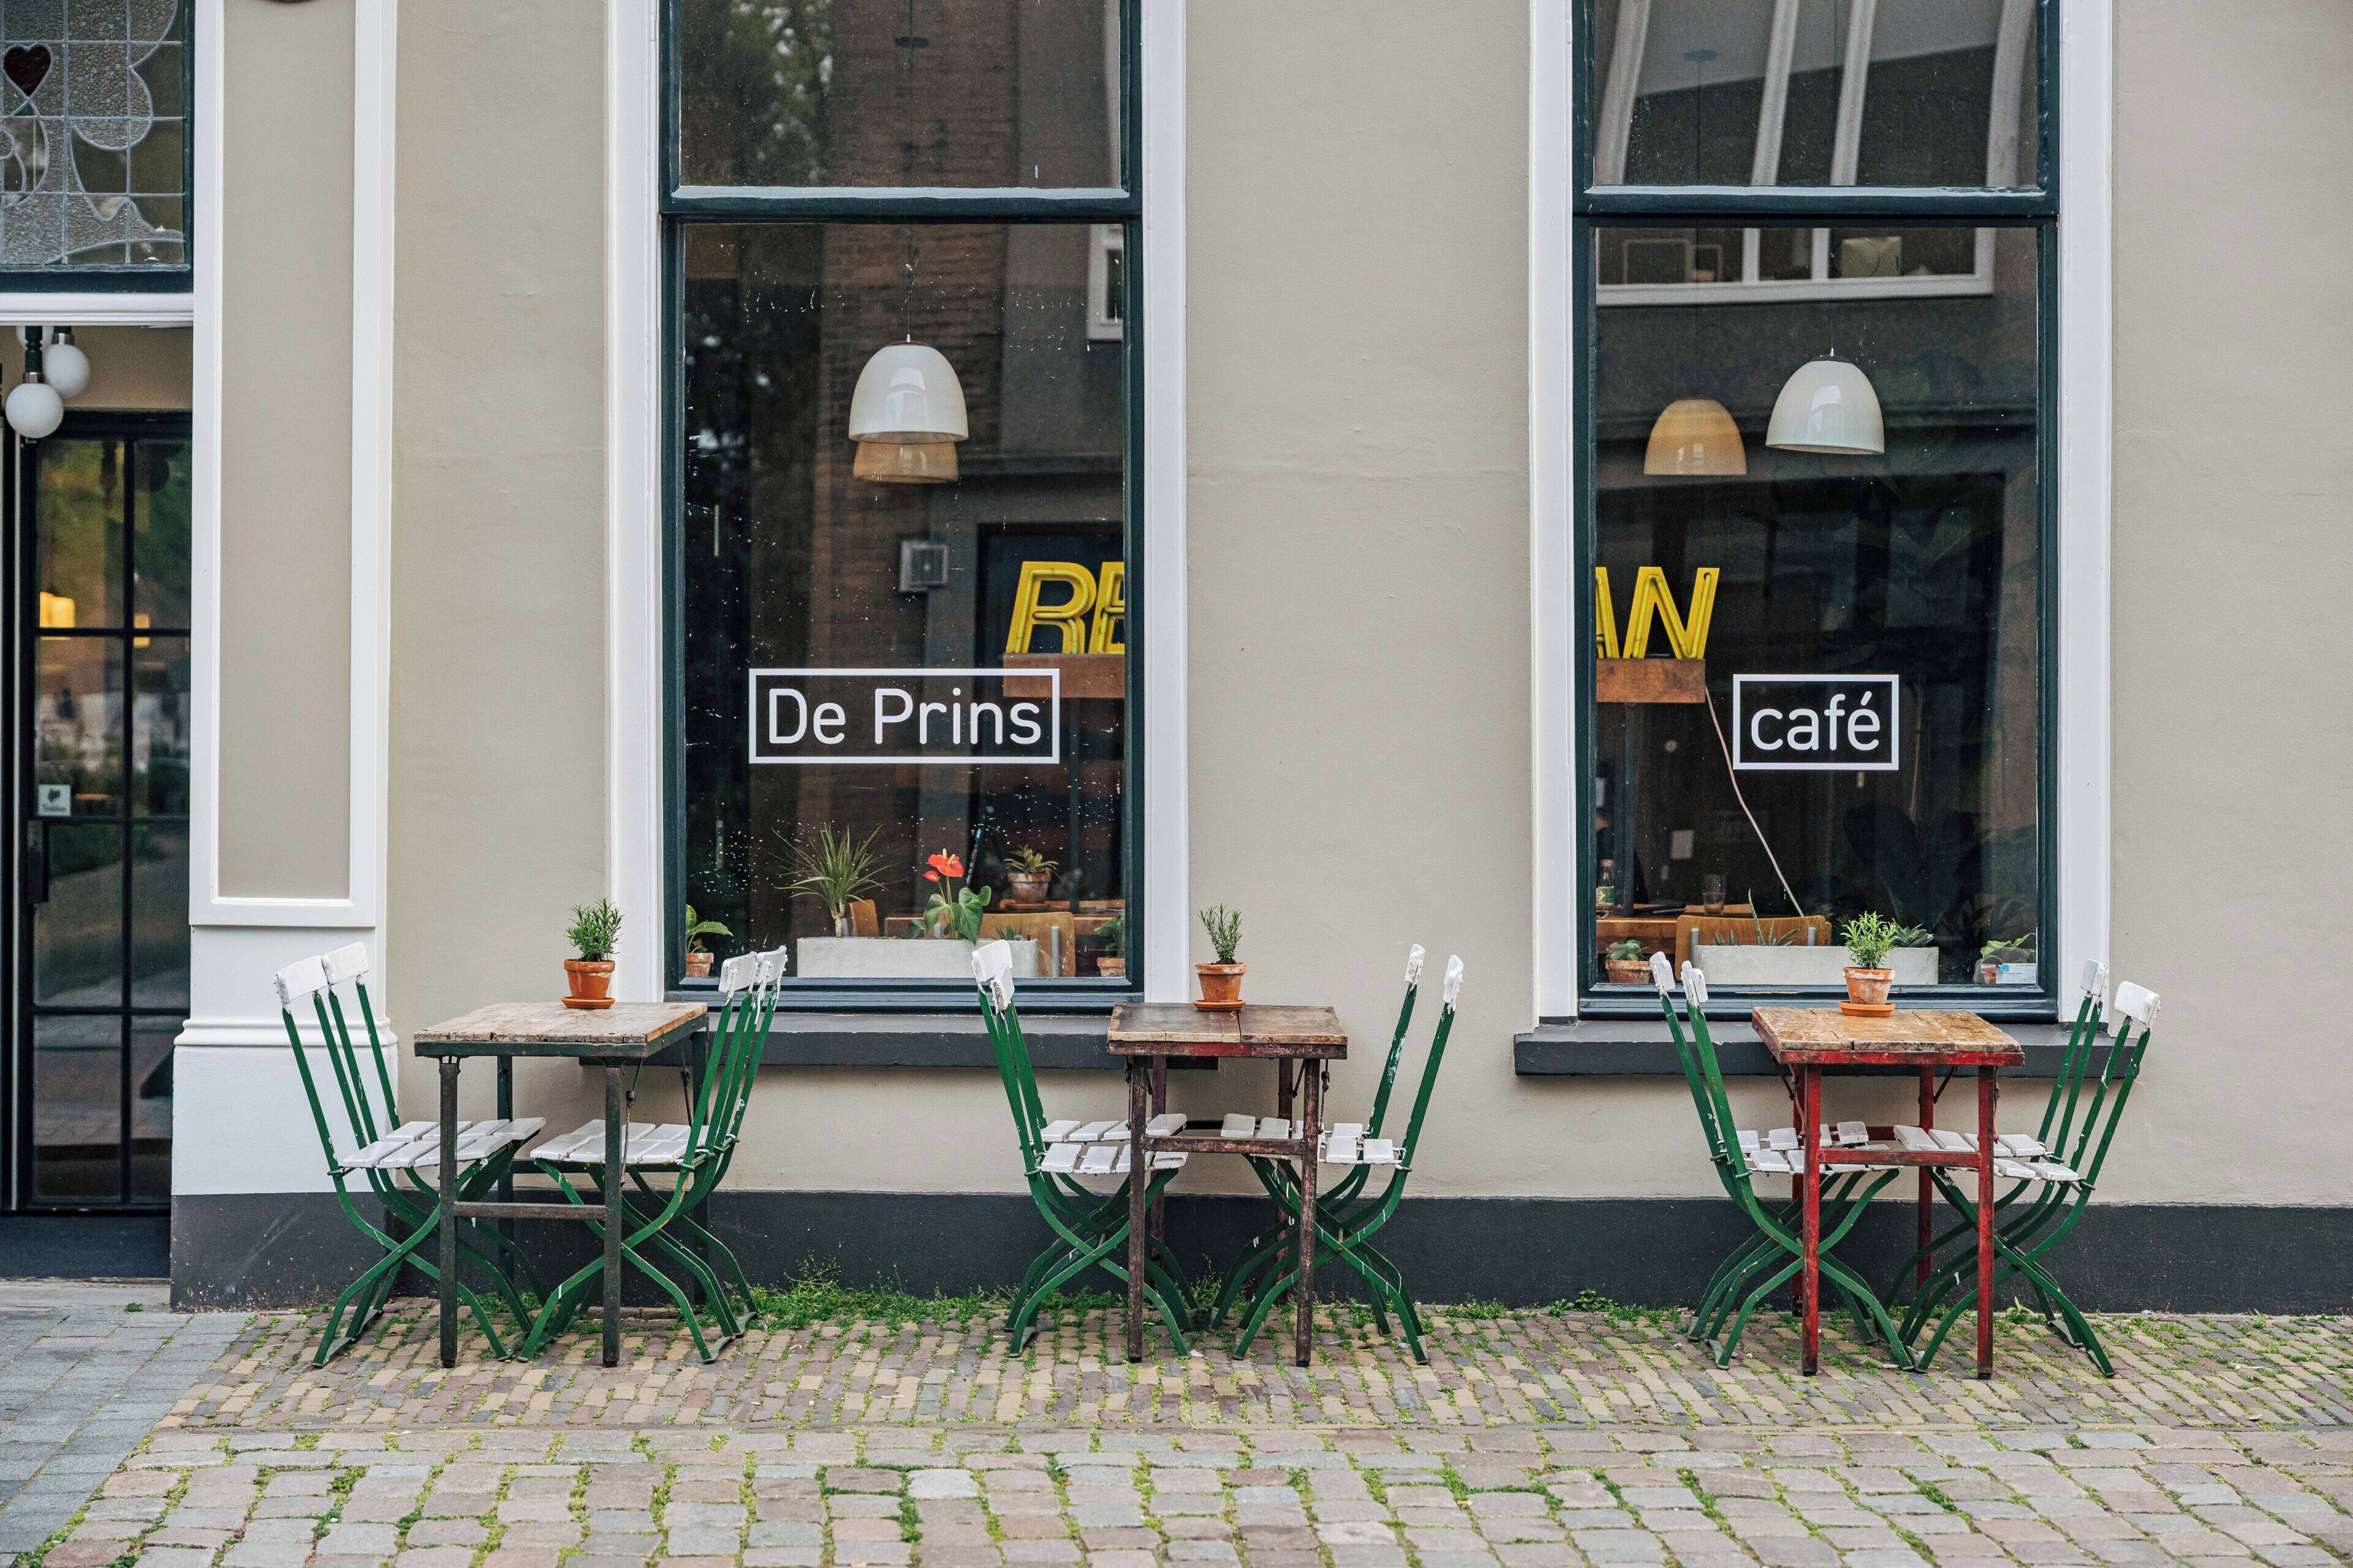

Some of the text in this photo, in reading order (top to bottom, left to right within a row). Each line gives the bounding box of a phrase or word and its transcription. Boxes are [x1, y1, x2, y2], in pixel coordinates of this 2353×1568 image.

[769, 687, 1041, 744] De Prins
[1751, 691, 1880, 751] café
